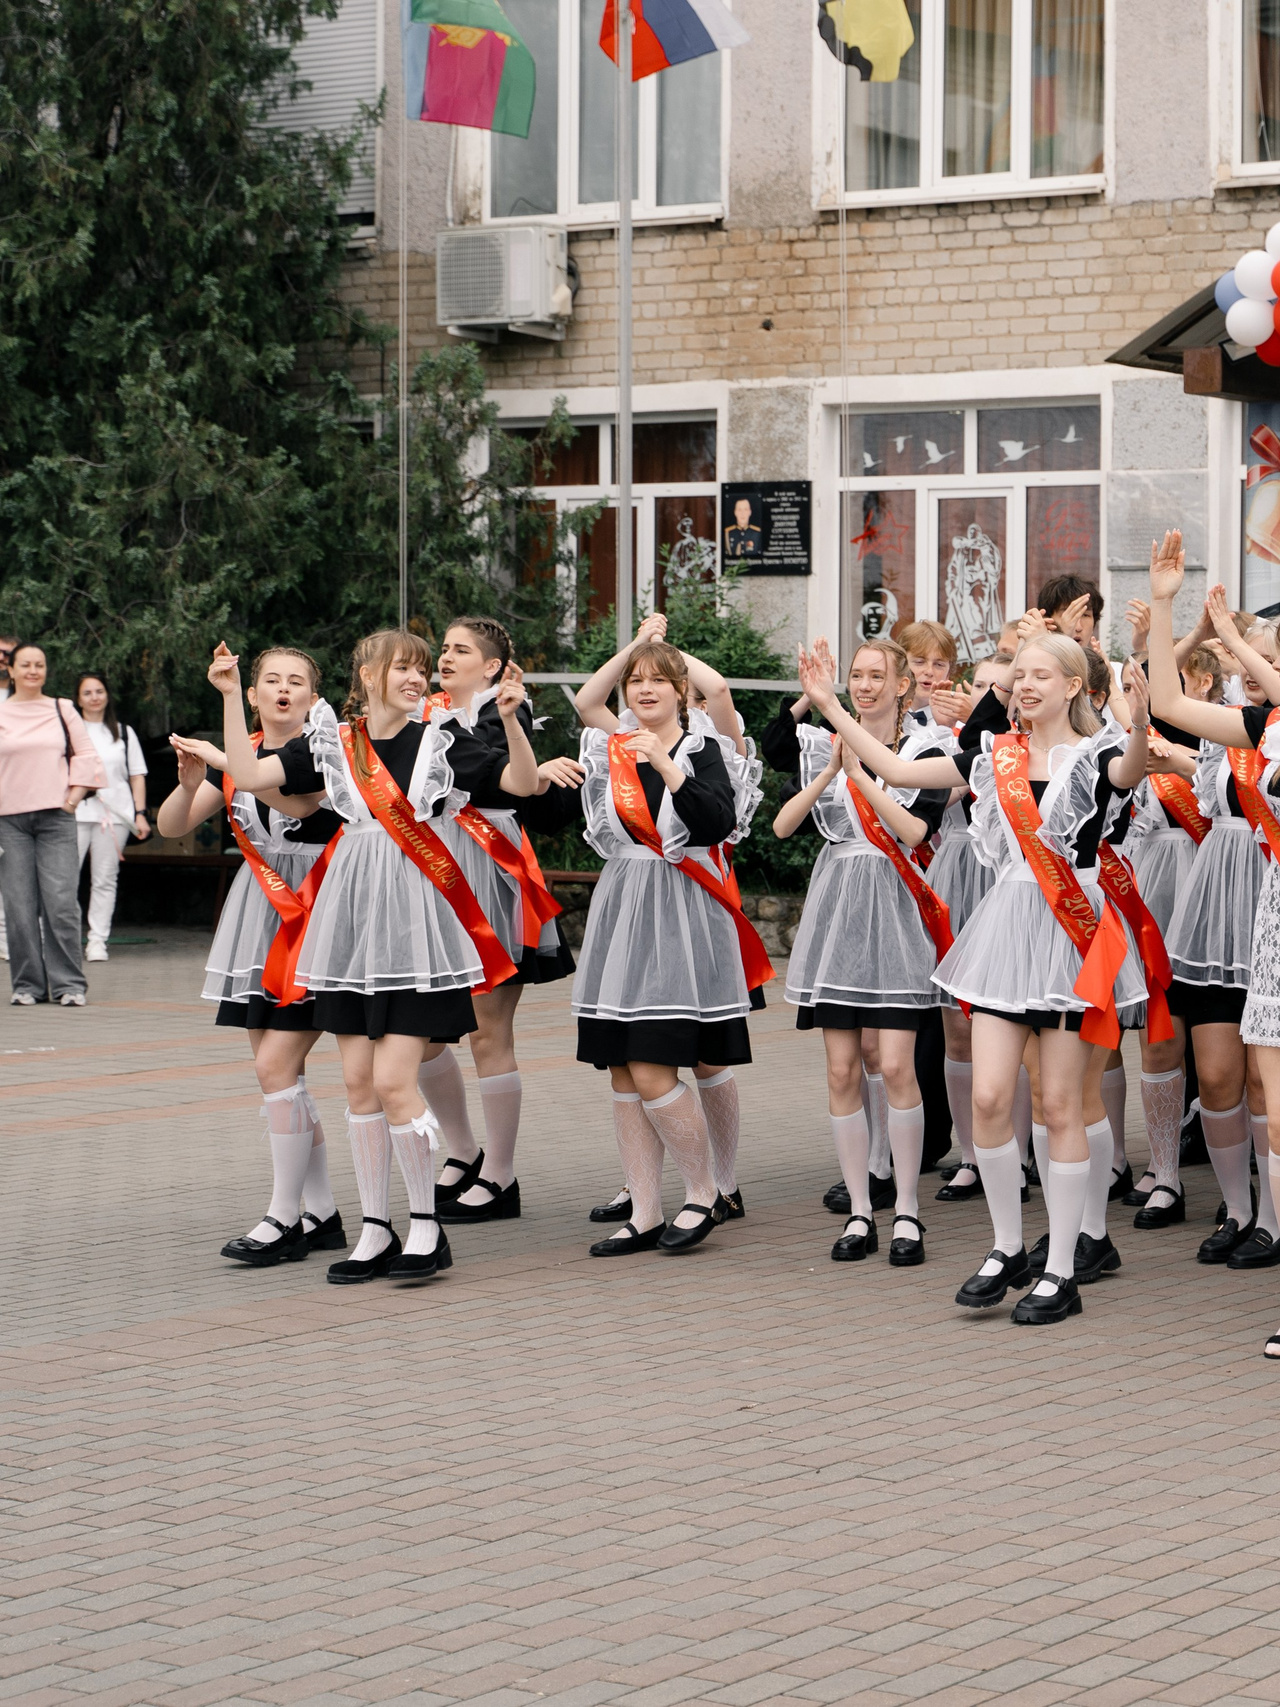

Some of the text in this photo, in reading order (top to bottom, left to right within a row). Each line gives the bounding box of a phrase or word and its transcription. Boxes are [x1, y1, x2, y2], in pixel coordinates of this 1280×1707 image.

[1006, 779, 1069, 894] Выпускница
[427, 855, 462, 890] 2026
[1100, 853, 1132, 894] 2026
